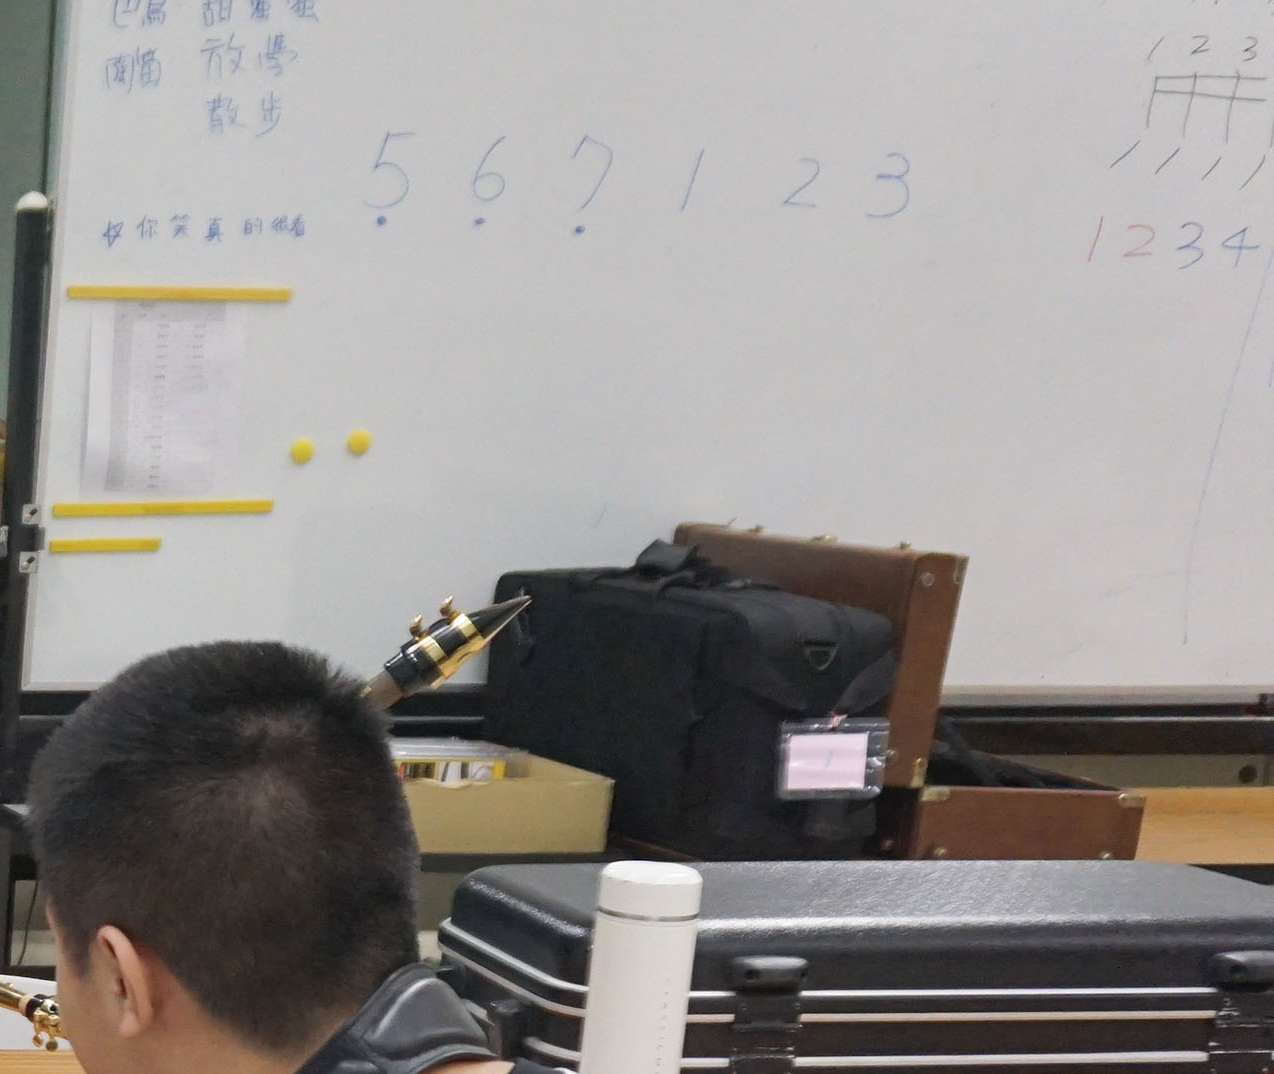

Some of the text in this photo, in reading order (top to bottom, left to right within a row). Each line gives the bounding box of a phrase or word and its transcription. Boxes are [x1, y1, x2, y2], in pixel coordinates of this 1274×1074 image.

[1190, 34, 1210, 56] 2
[1242, 35, 1259, 62] 3
[363, 131, 417, 209] 5
[472, 135, 507, 202] 6
[782, 158, 821, 208] 2
[865, 152, 911, 218] 3
[1122, 224, 1156, 258] 2
[1176, 221, 1204, 270] 3
[1221, 226, 1261, 268] 4
